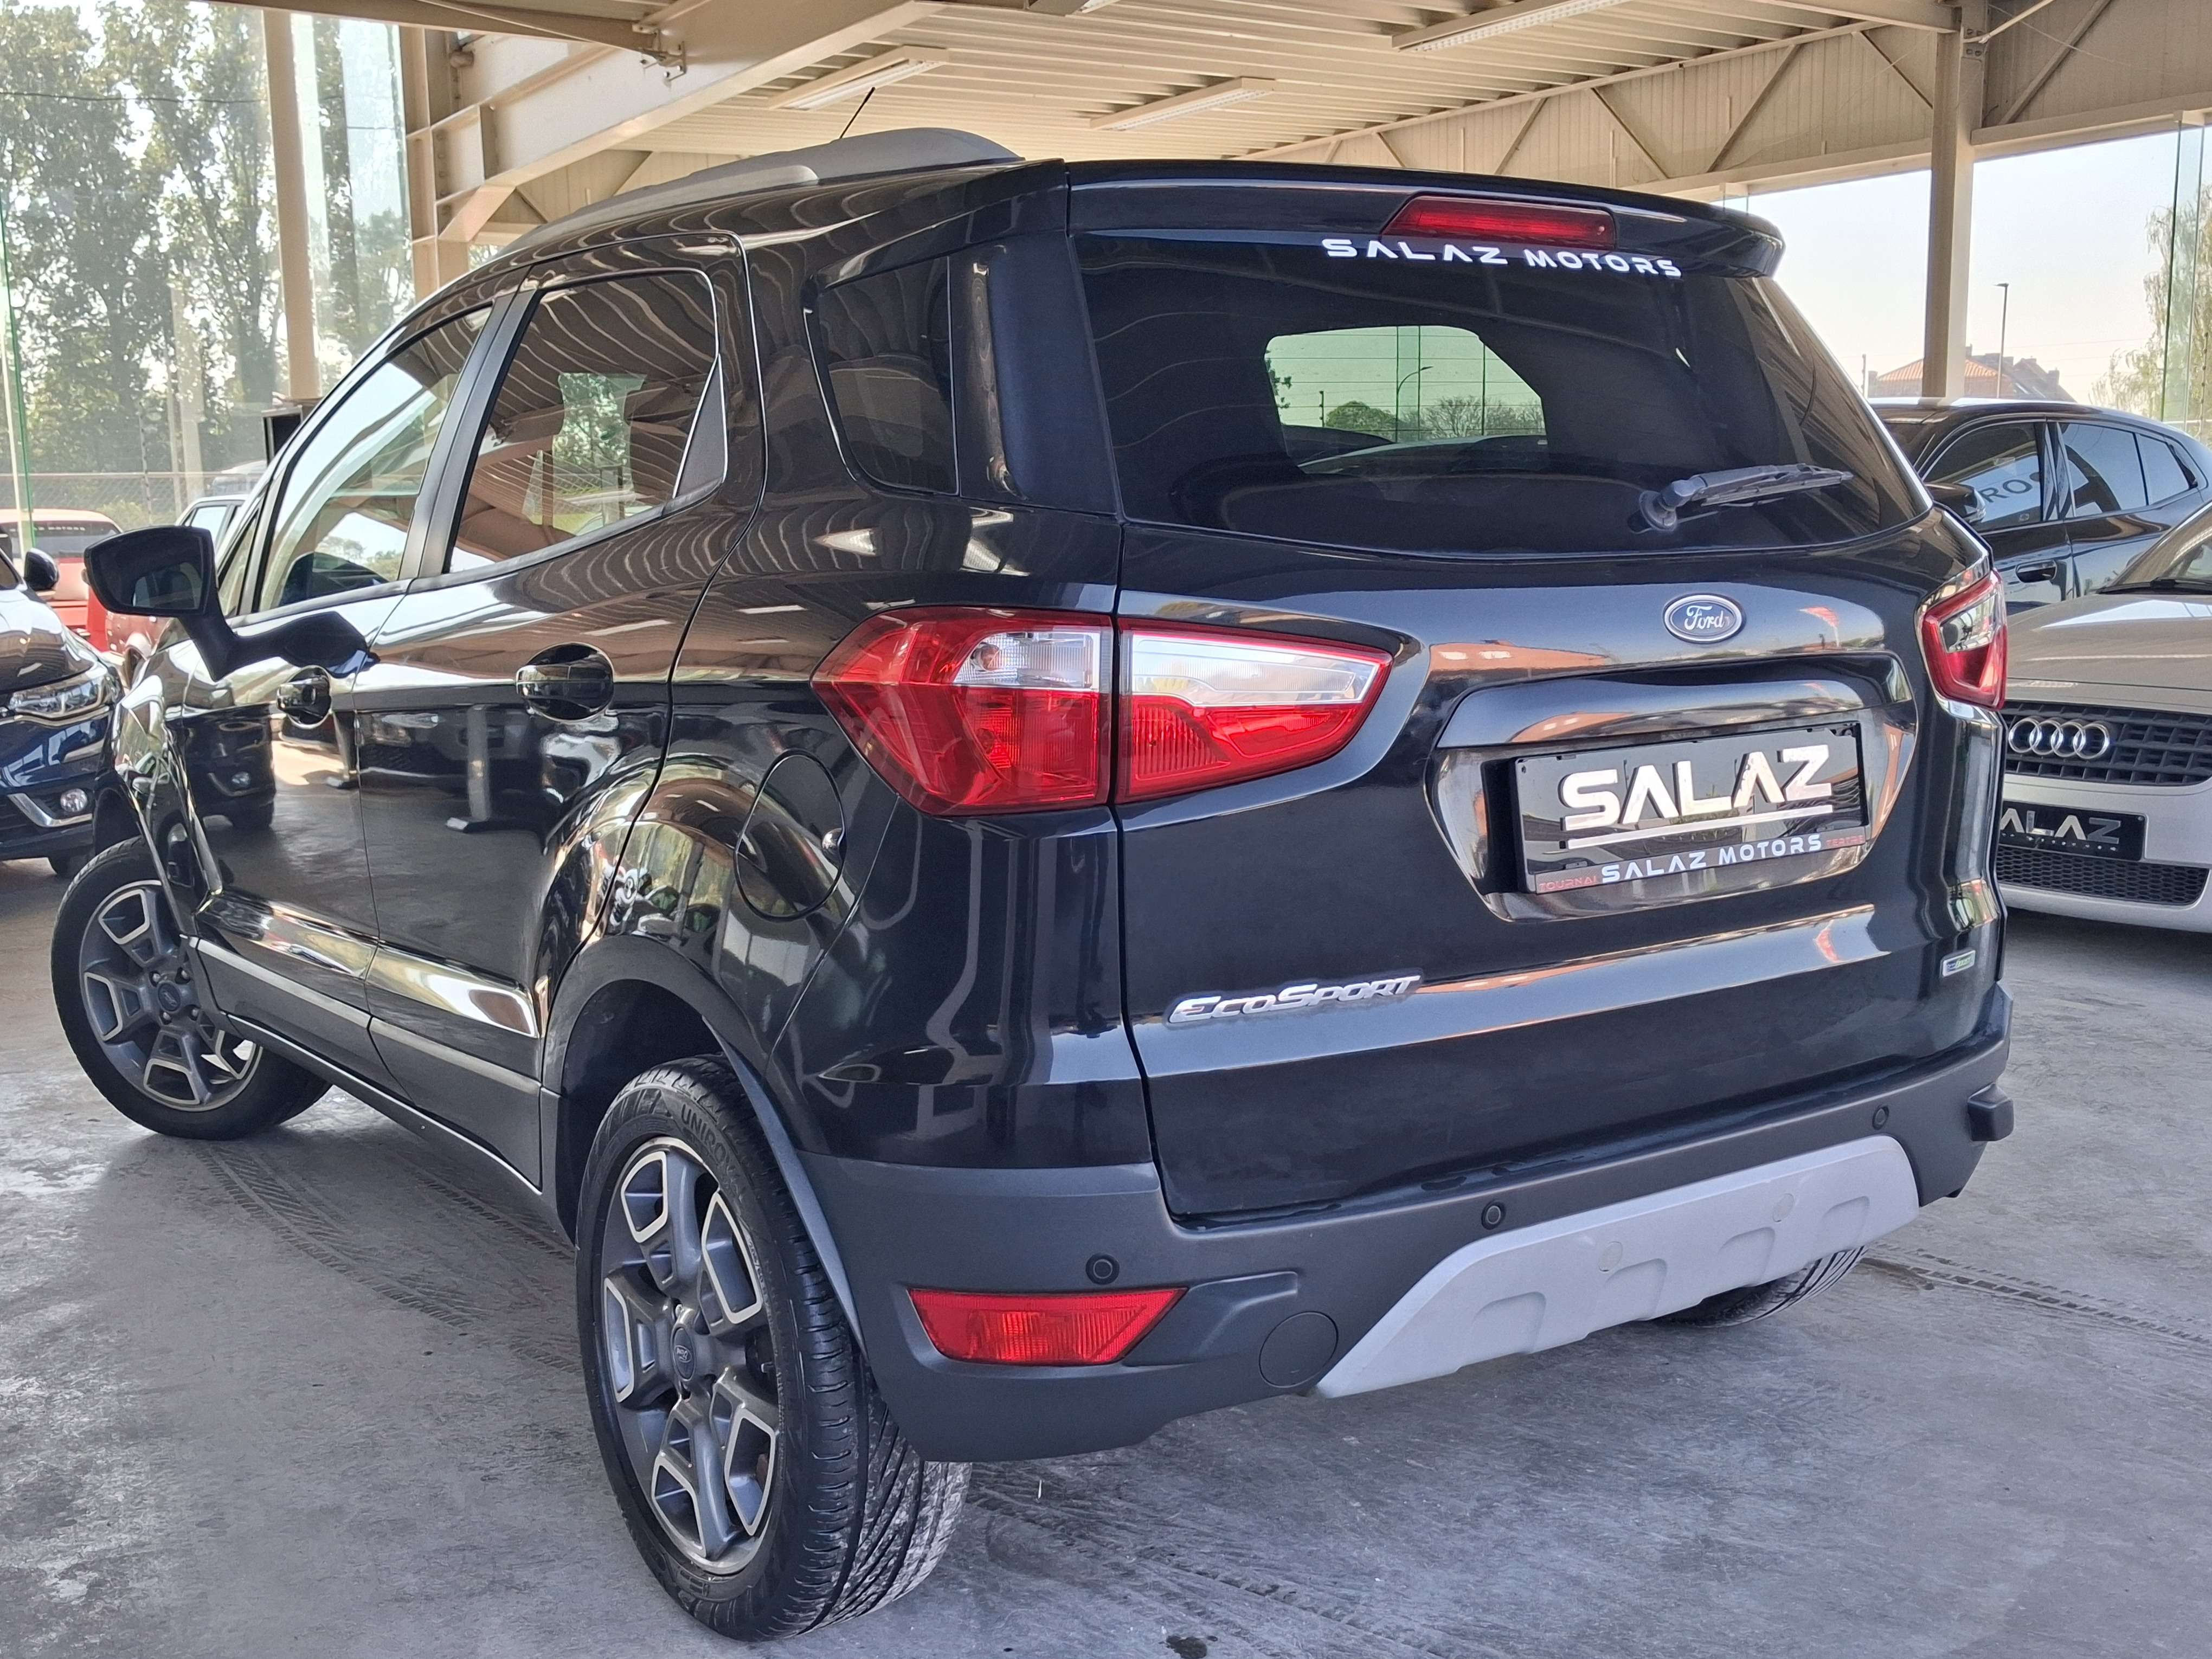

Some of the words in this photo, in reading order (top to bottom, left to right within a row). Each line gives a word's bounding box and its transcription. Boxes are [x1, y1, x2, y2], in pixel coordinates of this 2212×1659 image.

[1321, 239, 1508, 265] SALAZ
[1523, 248, 1682, 278] MOTORS
[1684, 605, 1725, 631] Ford
[1560, 744, 1833, 831] SALAZ
[1539, 876, 1597, 891] TOURNAI
[1601, 851, 1707, 884] SALAZ
[1719, 834, 1821, 865] MOTORS
